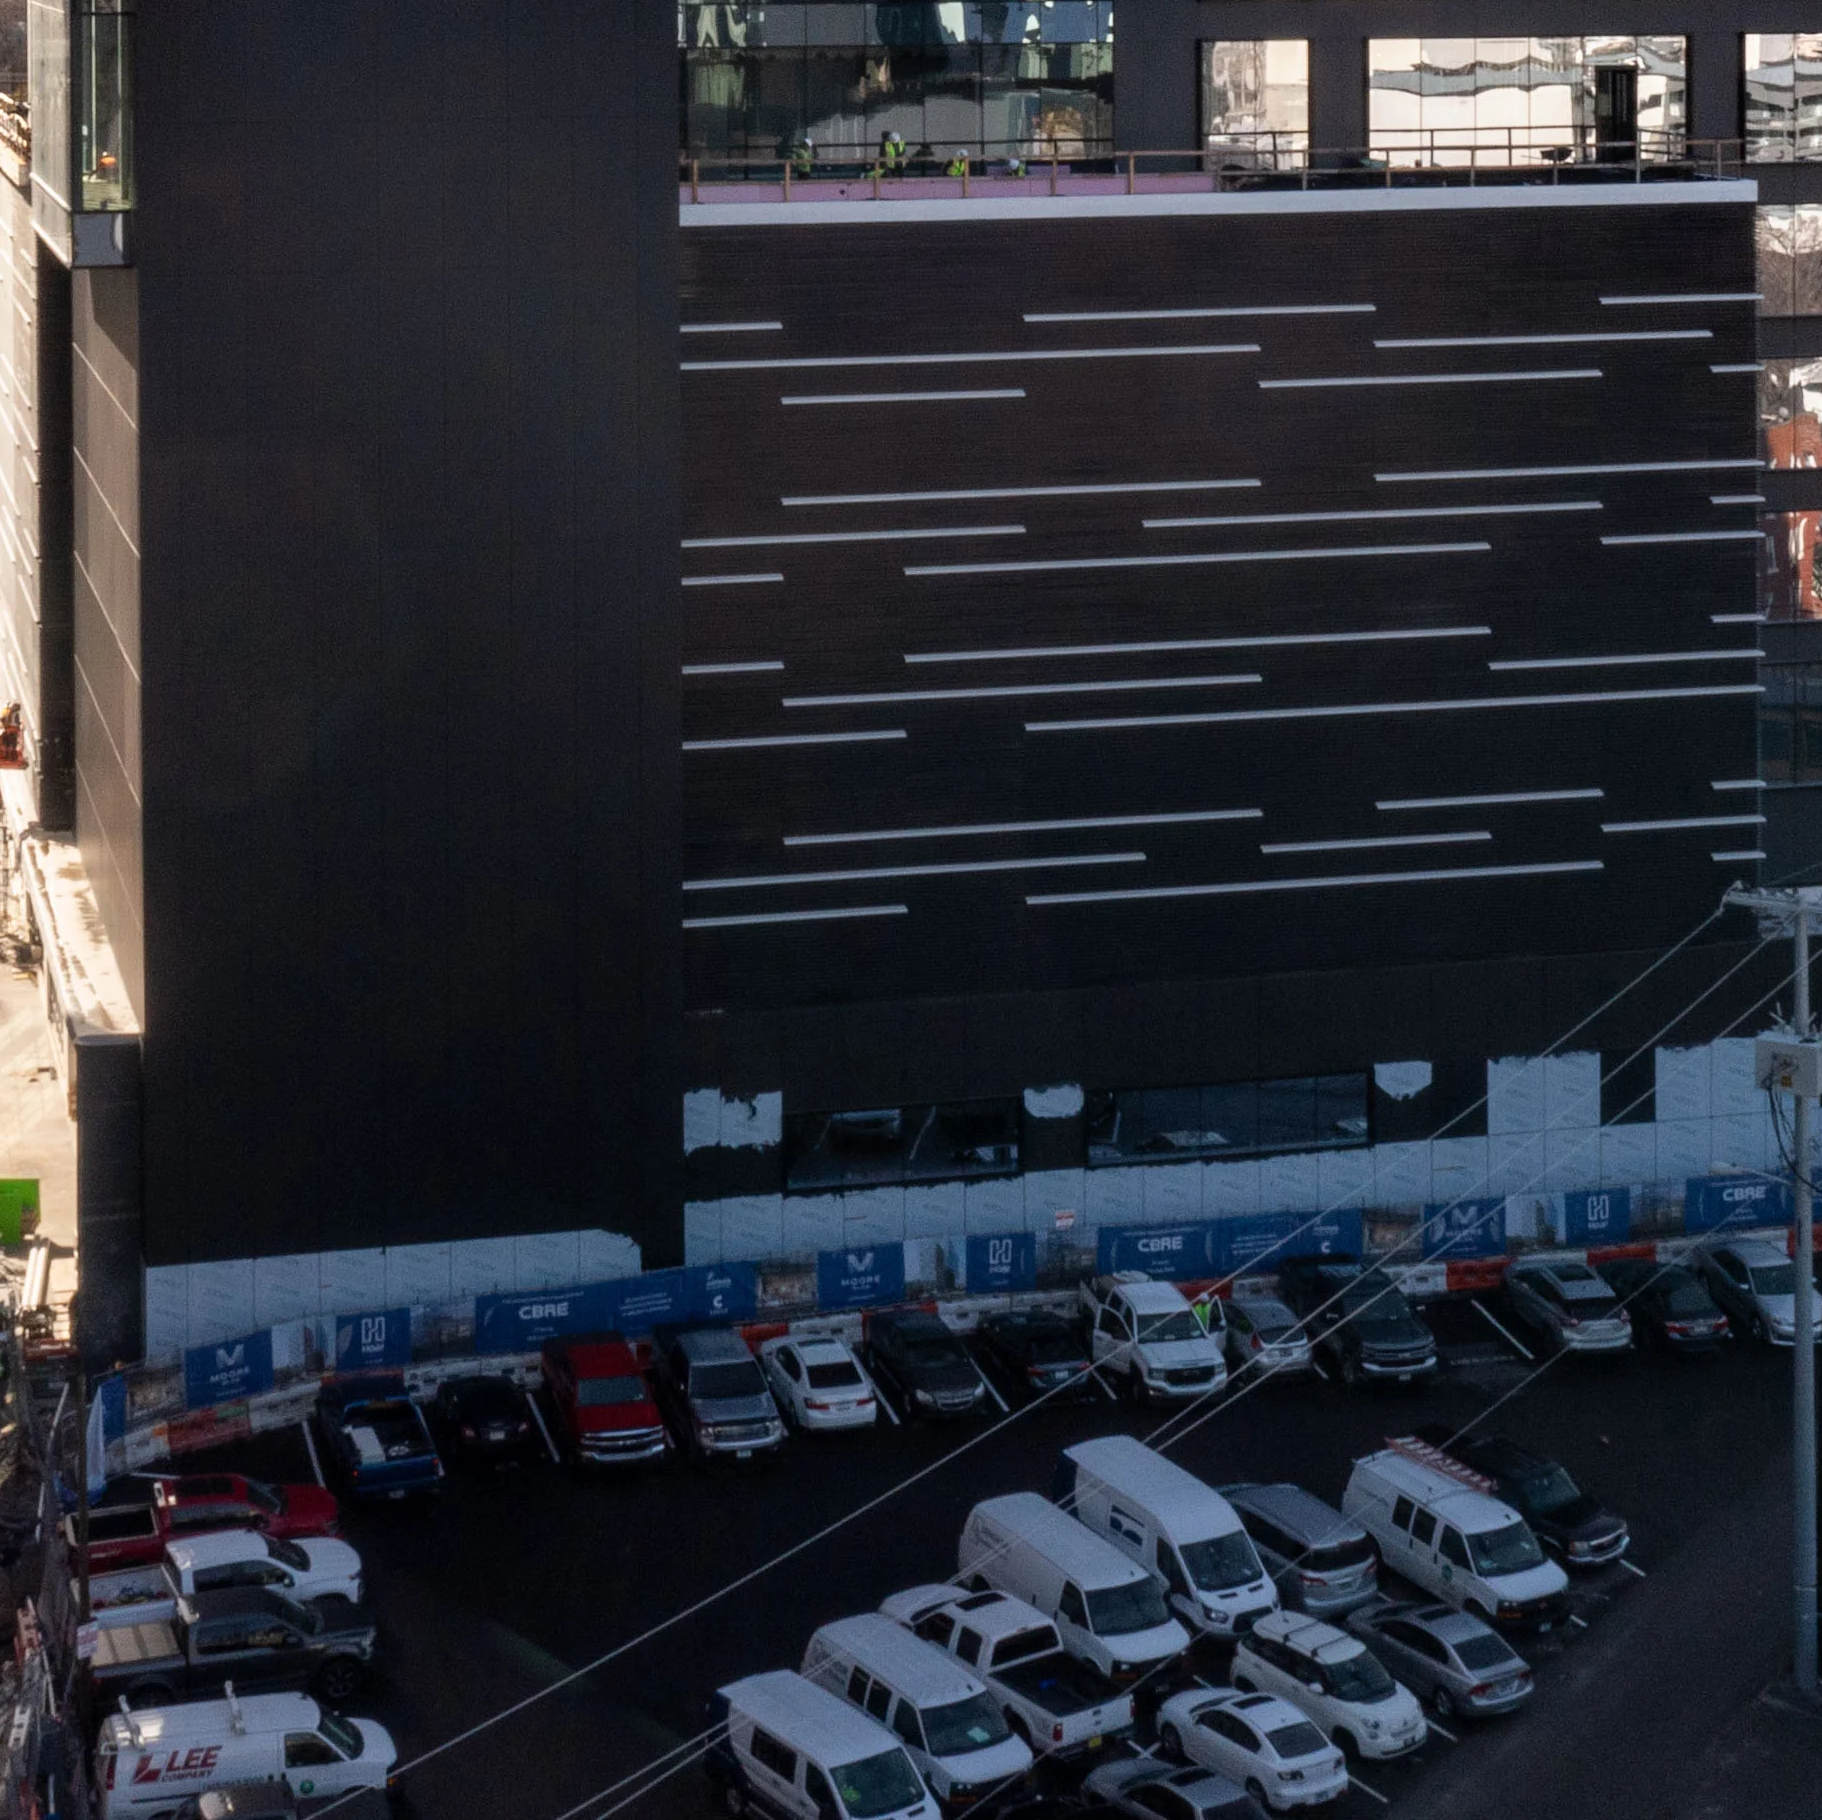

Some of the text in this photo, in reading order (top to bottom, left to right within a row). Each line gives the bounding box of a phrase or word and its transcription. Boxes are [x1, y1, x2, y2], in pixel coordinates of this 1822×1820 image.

[1722, 1185, 1767, 1202] CBRE
[1137, 1236, 1183, 1253] CBRE
[518, 1302, 570, 1320] CBRE
[166, 1745, 223, 1772] LEE
[162, 1769, 214, 1783] COMPANY
